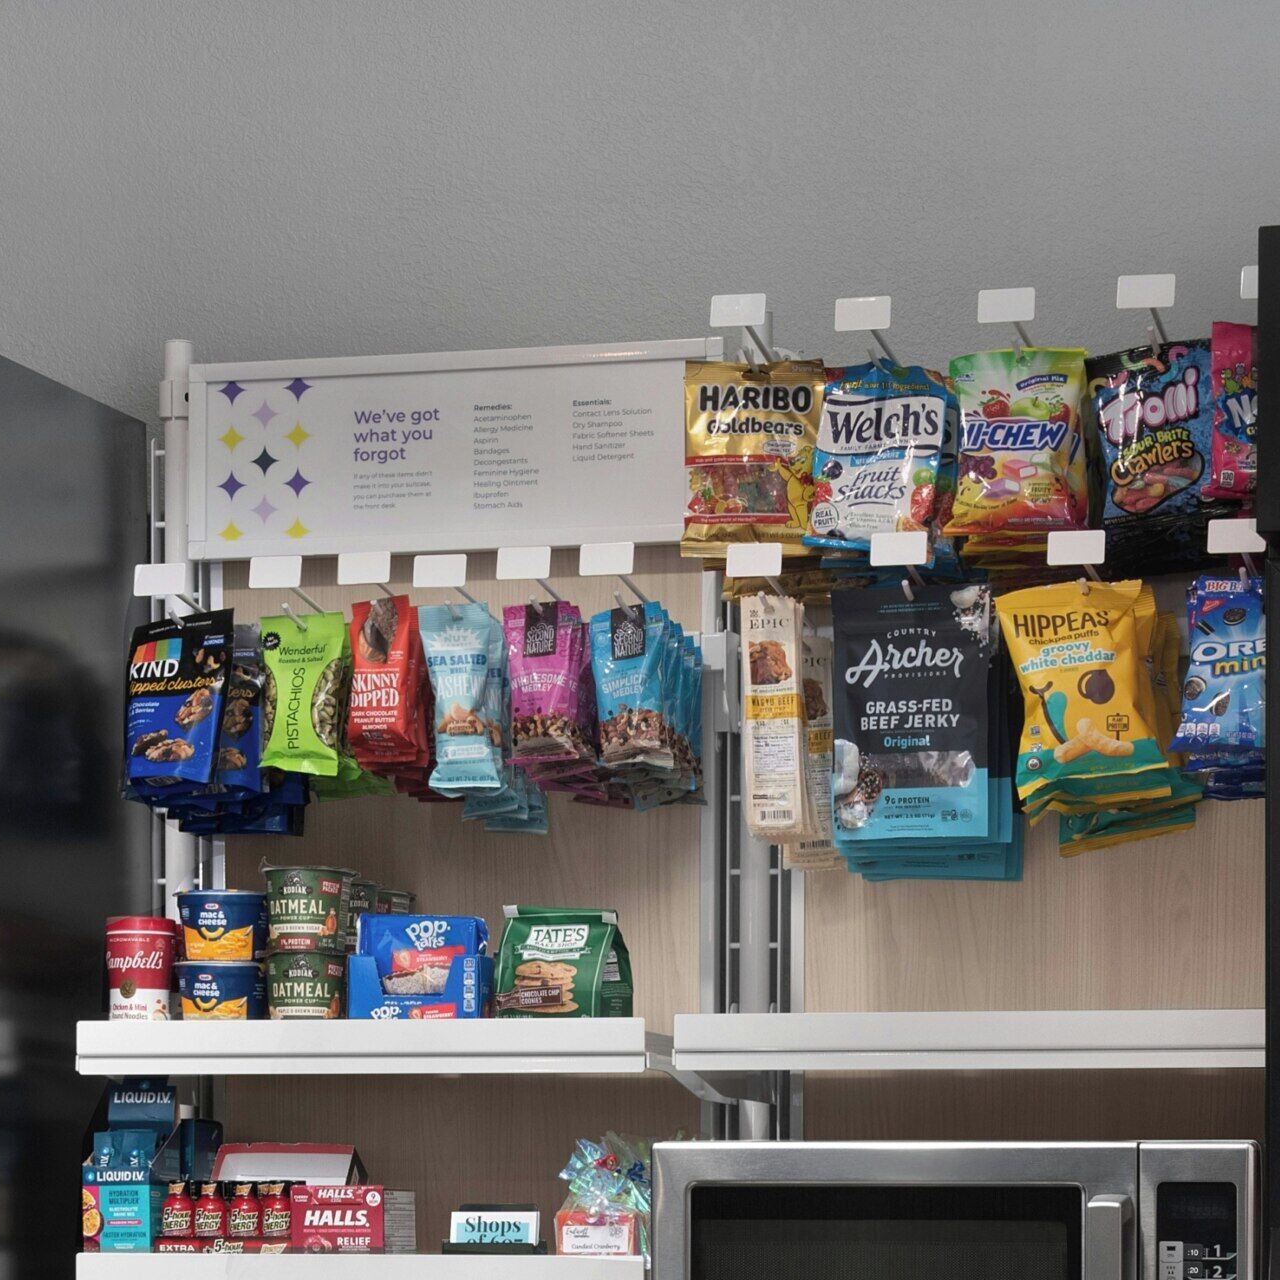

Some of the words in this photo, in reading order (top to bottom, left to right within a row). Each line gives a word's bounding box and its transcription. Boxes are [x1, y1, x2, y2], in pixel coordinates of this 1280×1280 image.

[700, 384, 812, 412] HARIBO
[354, 409, 405, 424] We've
[411, 408, 440, 425] got
[474, 414, 531, 422] Acetaminophen
[828, 403, 940, 443] Welch's
[474, 425, 498, 433] Allergy
[588, 421, 622, 429] Shampoo
[707, 418, 803, 437] Goldbears
[354, 429, 396, 443] what
[402, 429, 432, 444] you
[474, 437, 498, 445] Aspirin
[354, 448, 406, 463] forgot
[474, 457, 528, 465] Decongestants
[597, 453, 634, 462] Detergent
[510, 468, 539, 476] Hygiene
[474, 480, 501, 488] Healing
[750, 618, 790, 630] EPIC
[1013, 610, 1108, 636] HIPPEAS
[887, 628, 936, 639] COUNTRY
[1029, 633, 1070, 645] chickpea
[1073, 630, 1099, 642] puffs
[279, 646, 326, 656] Wonderful
[1041, 640, 1090, 659] groovy
[130, 660, 179, 678] KIND
[846, 639, 964, 687] Archer
[1020, 657, 1060, 675] white
[1063, 651, 1114, 667] cheddar
[352, 672, 399, 693] SKINNY
[884, 670, 947, 680] PROVISIONS
[351, 690, 398, 708] DIPPED
[866, 699, 952, 714] GRASS-FED
[286, 667, 304, 750] PISTACHIOS
[860, 715, 901, 731] BEEF
[904, 714, 959, 728] JERKY
[884, 735, 930, 749] Original
[271, 899, 325, 916] OATMEAL
[534, 926, 588, 945] TATE'S
[97, 1171, 129, 1181] LIQUID
[131, 1171, 145, 1181] I.V.
[464, 1216, 520, 1236] Shops
[1212, 1245, 1222, 1257] 1
[1212, 1266, 1222, 1278] 2
